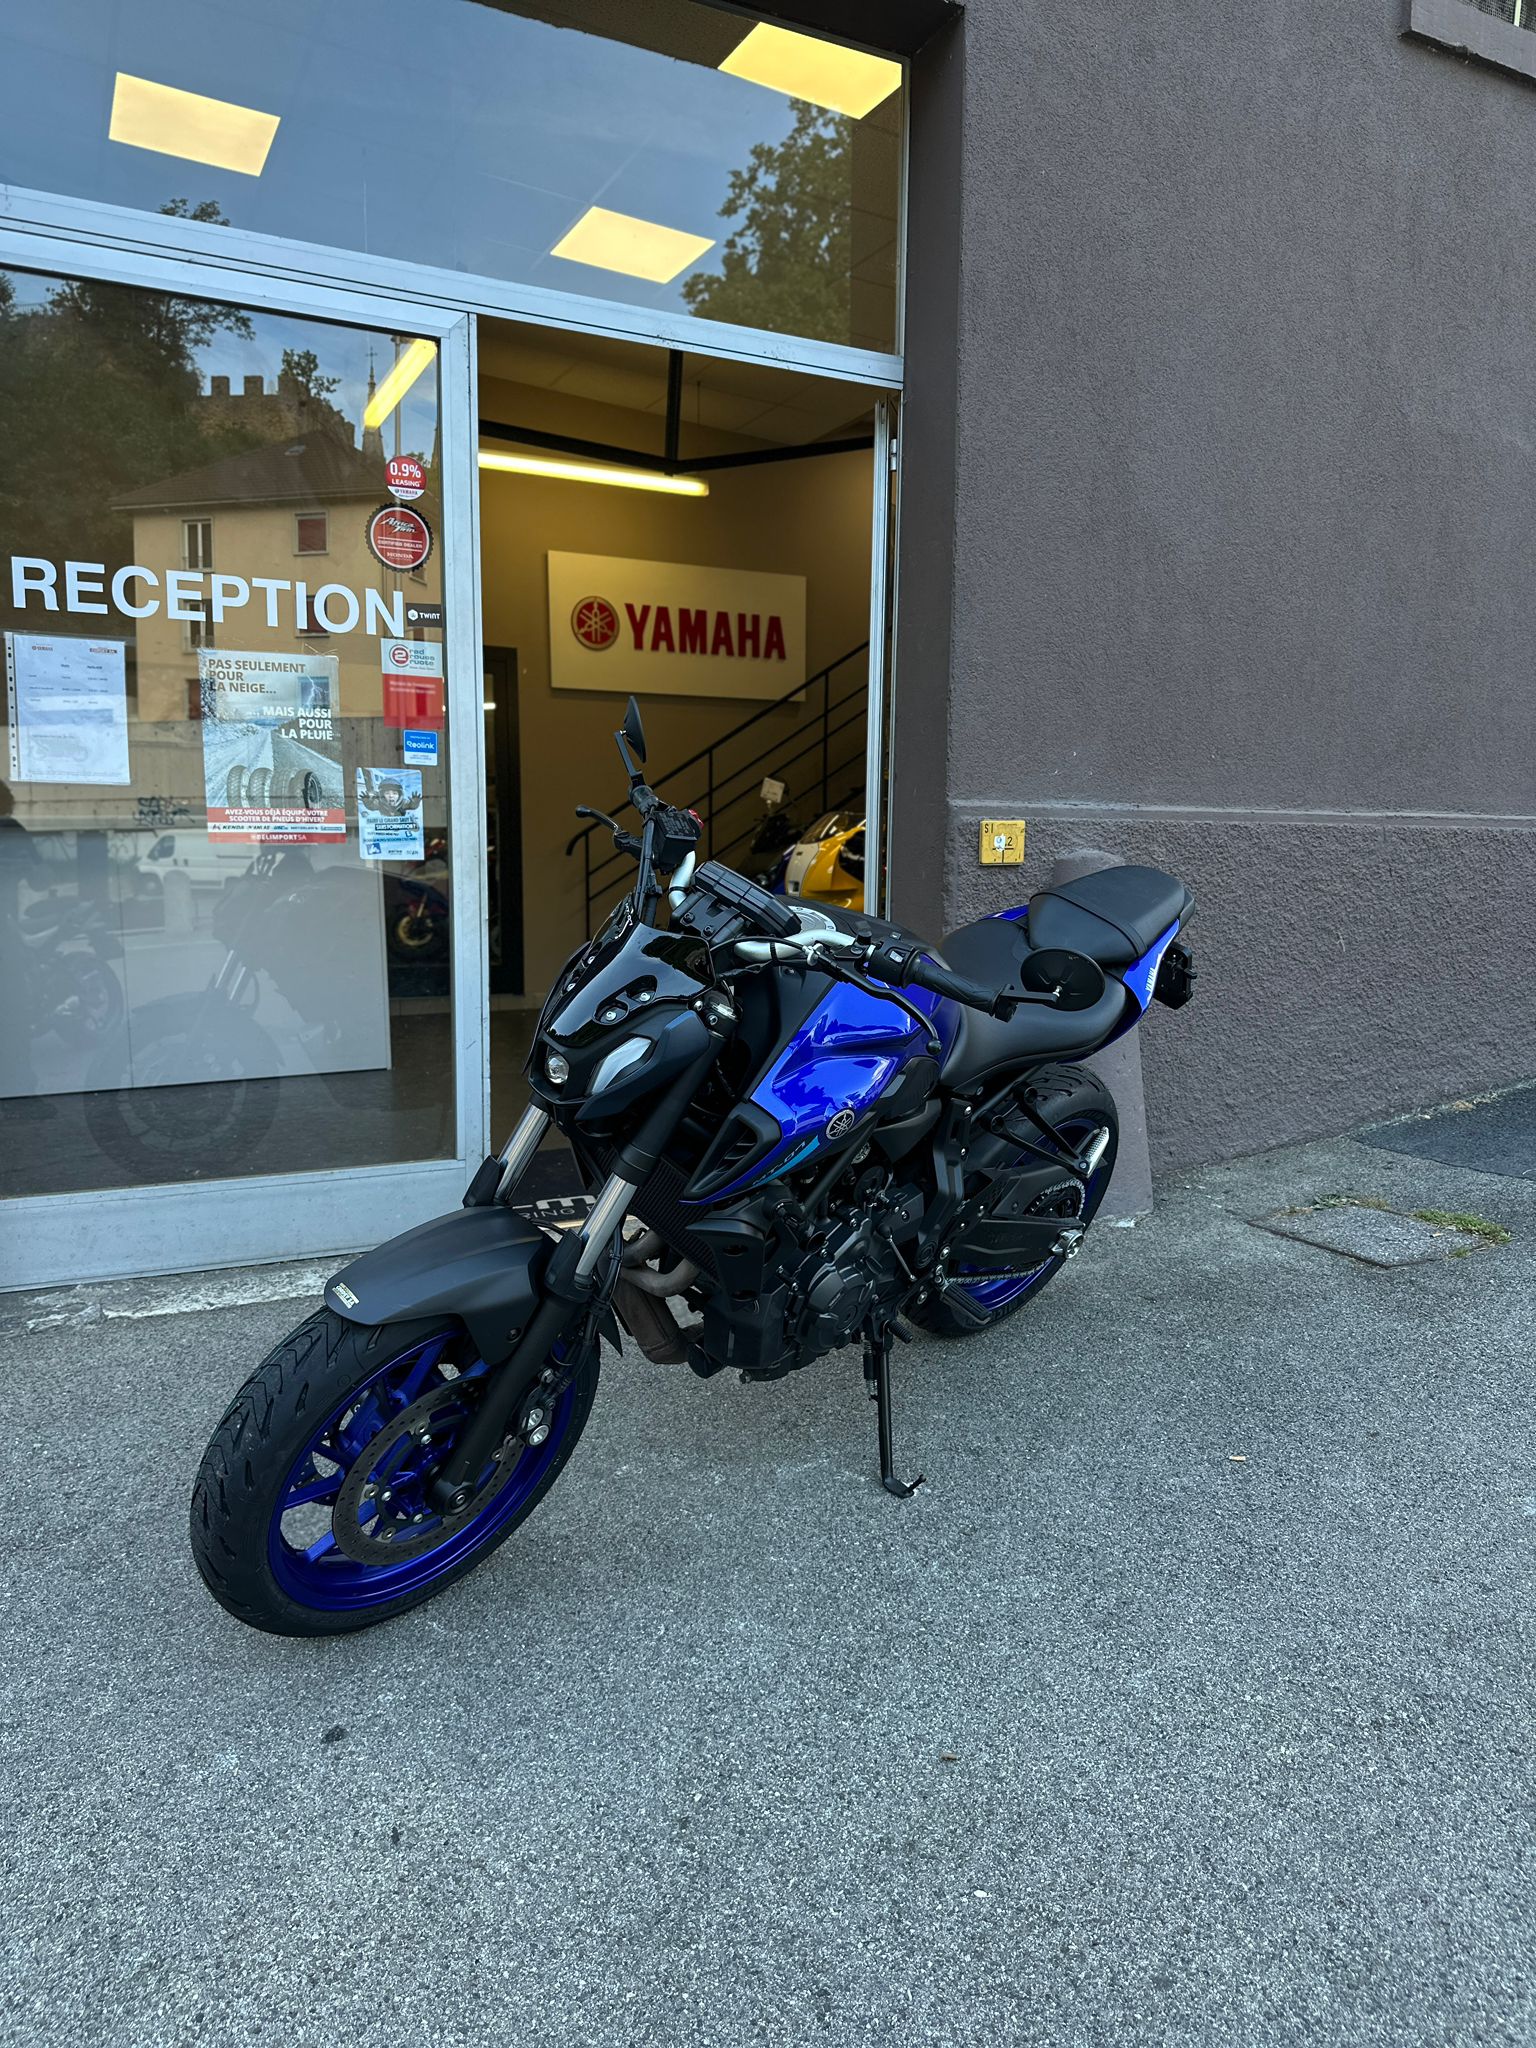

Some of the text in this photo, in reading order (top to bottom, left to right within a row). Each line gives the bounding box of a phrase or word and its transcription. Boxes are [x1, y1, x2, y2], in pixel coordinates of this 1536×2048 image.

[389, 462, 421, 478] 0.9%
[391, 479, 420, 487] LEASING
[11, 556, 405, 638] RECEPTION
[624, 602, 787, 661] YAMAHA
[208, 659, 306, 673] PAS SEULEMENT
[208, 670, 244, 681] POUR
[229, 683, 276, 694] NEIGE...
[263, 706, 295, 717] MAIS
[297, 708, 332, 718] AUSSI
[298, 718, 333, 729] POUR
[281, 729, 333, 740] LA PLUIE
[406, 740, 435, 750] Reolink
